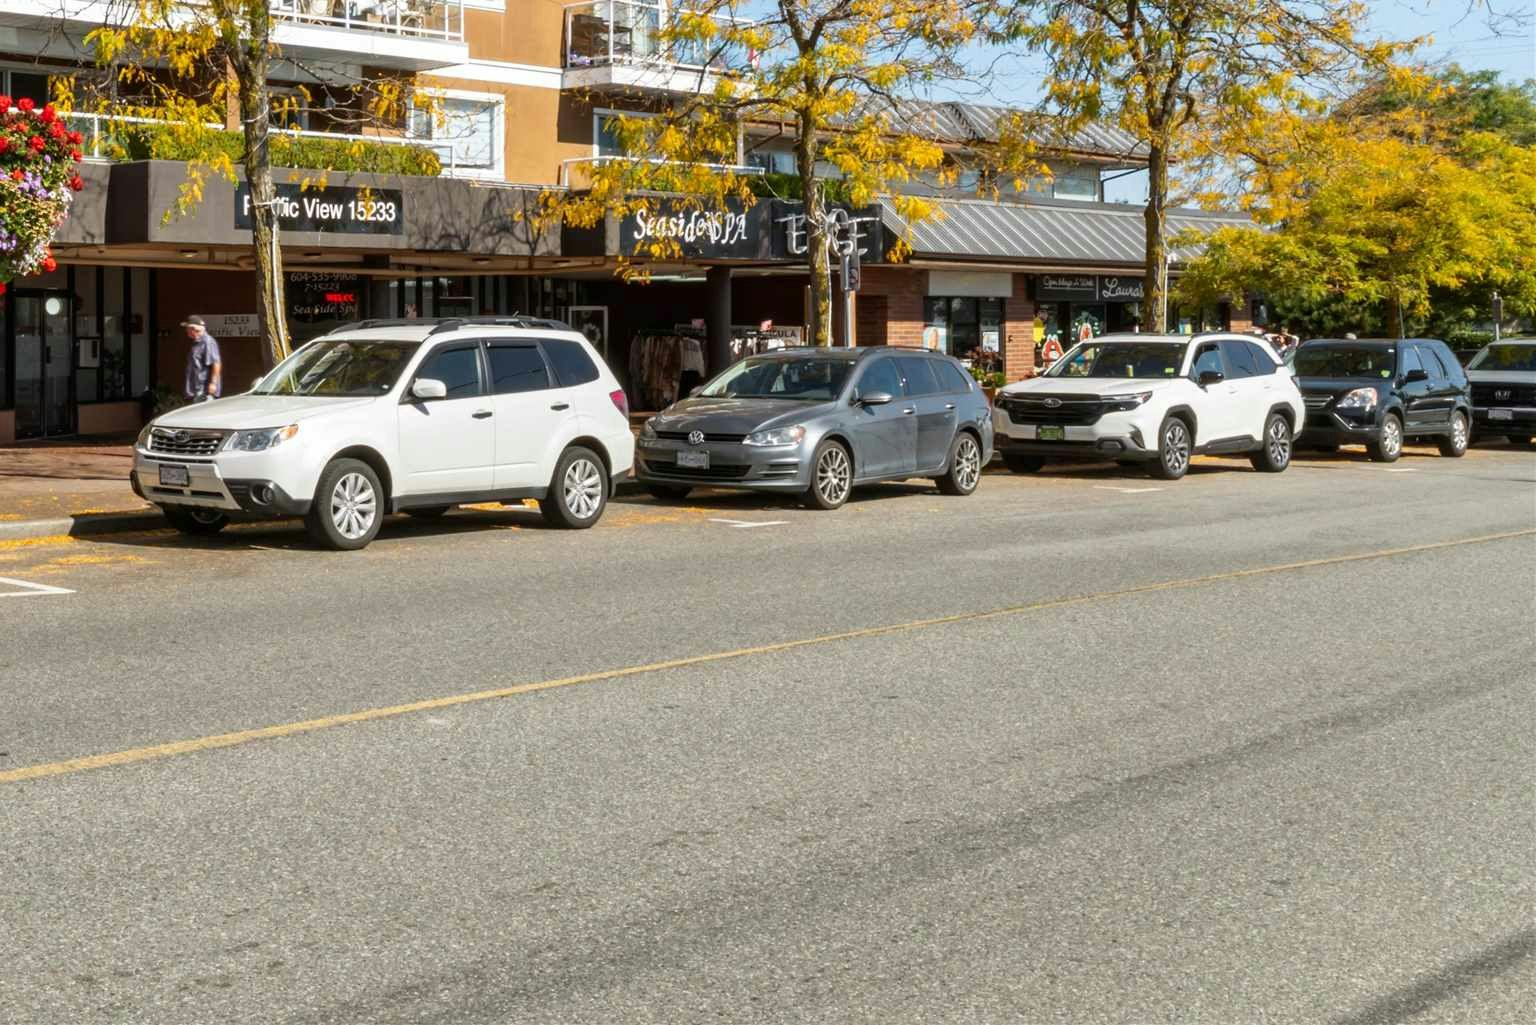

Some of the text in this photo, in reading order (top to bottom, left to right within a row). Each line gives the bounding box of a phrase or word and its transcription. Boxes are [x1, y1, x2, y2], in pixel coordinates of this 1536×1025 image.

[303, 197, 343, 220] View
[348, 200, 396, 222] 15233
[633, 208, 706, 242] Seaside
